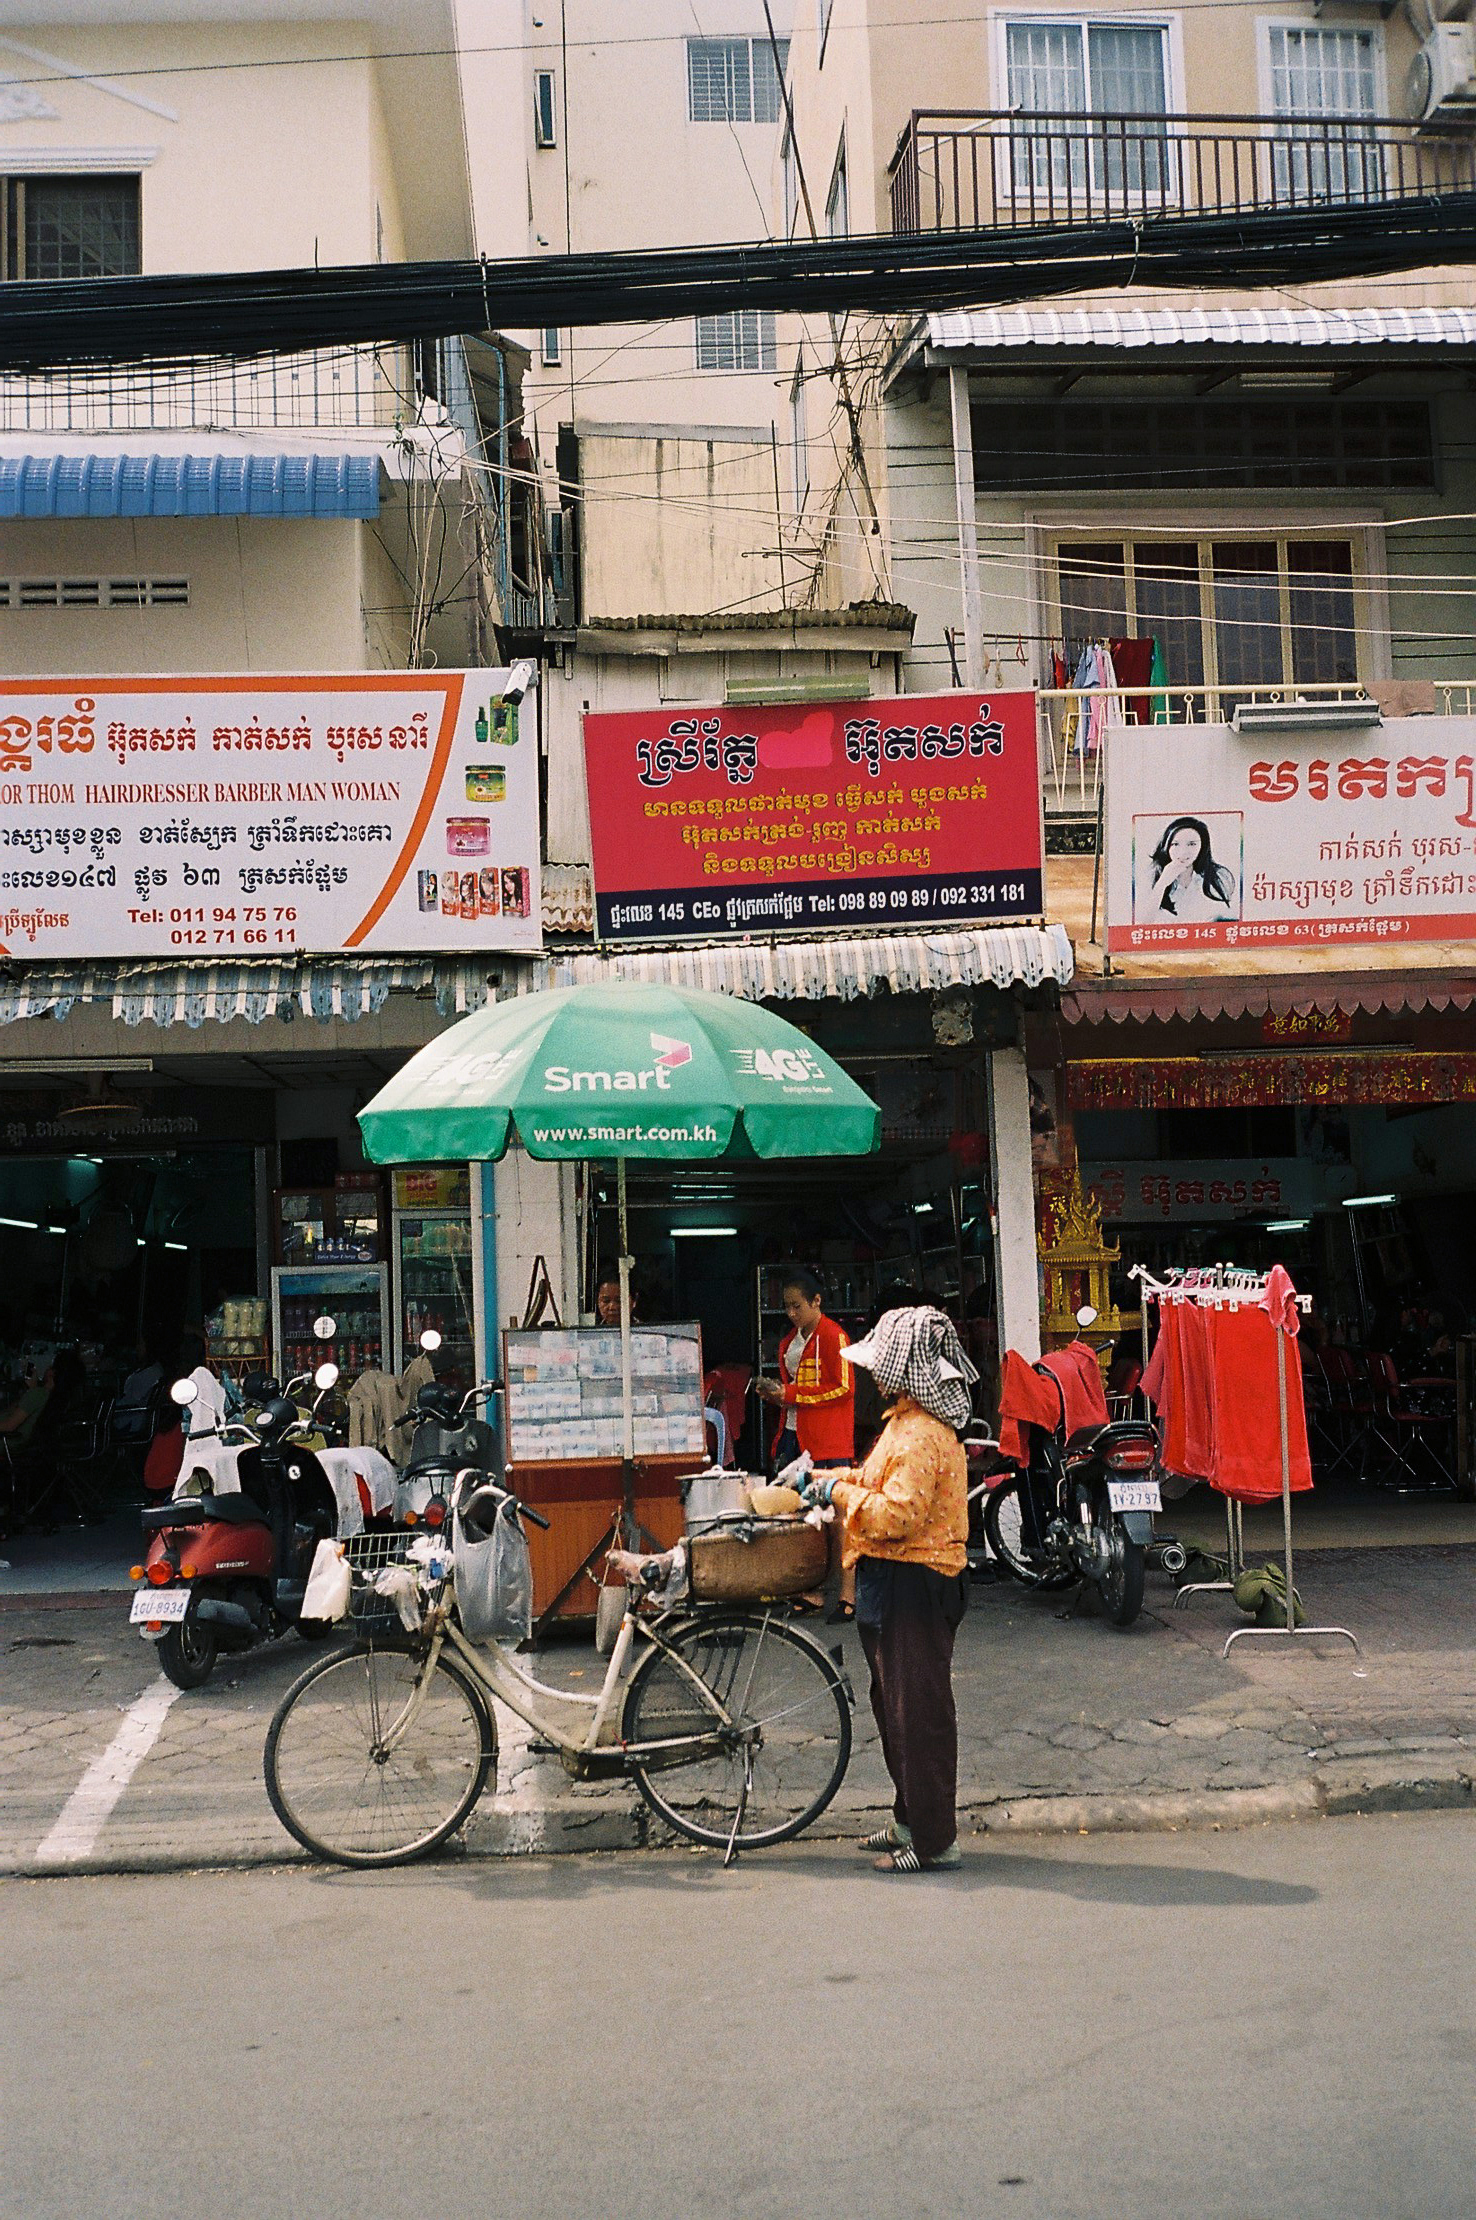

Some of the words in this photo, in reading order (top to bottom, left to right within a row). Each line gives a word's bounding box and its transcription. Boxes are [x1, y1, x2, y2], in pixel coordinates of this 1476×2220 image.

[108, 716, 196, 765] អ៊ុតសក់
[212, 715, 312, 751] កាត់សក់
[327, 726, 382, 763] បុរស
[389, 712, 429, 749] នារី
[844, 703, 1005, 777] អ៊ុតសក់
[0, 784, 22, 804] OR
[27, 784, 75, 804] THOM
[86, 783, 209, 804] HAIRDRESSER
[215, 782, 281, 803] BARBER
[288, 782, 326, 802] MAN
[331, 781, 401, 802] WOMAN
[855, 808, 941, 836] កាត់សក់
[1319, 830, 1402, 861] កាត់សក់
[135, 866, 168, 901] ផ្លូវ
[183, 863, 220, 886] ៦៣
[128, 909, 164, 923] Tel:
[170, 908, 204, 923] 011
[213, 908, 236, 922] 94
[243, 907, 266, 922] 75
[274, 907, 297, 921] 76
[658, 903, 684, 921] 145
[809, 894, 836, 913] Tel:
[839, 891, 865, 911] 098
[869, 891, 886, 909] 89
[891, 890, 908, 908] 09
[911, 889, 929, 907] 89
[940, 887, 967, 905] 092
[970, 885, 996, 903] 331
[1001, 883, 1025, 902] 181
[171, 930, 206, 945] 012
[214, 930, 235, 944] 71
[244, 929, 267, 943] 66
[275, 929, 296, 943] 11
[1194, 928, 1217, 939] 145
[545, 1065, 670, 1093] Smart
[754, 1048, 810, 1082] 4G
[534, 1123, 716, 1144] www.smart.com.kh
